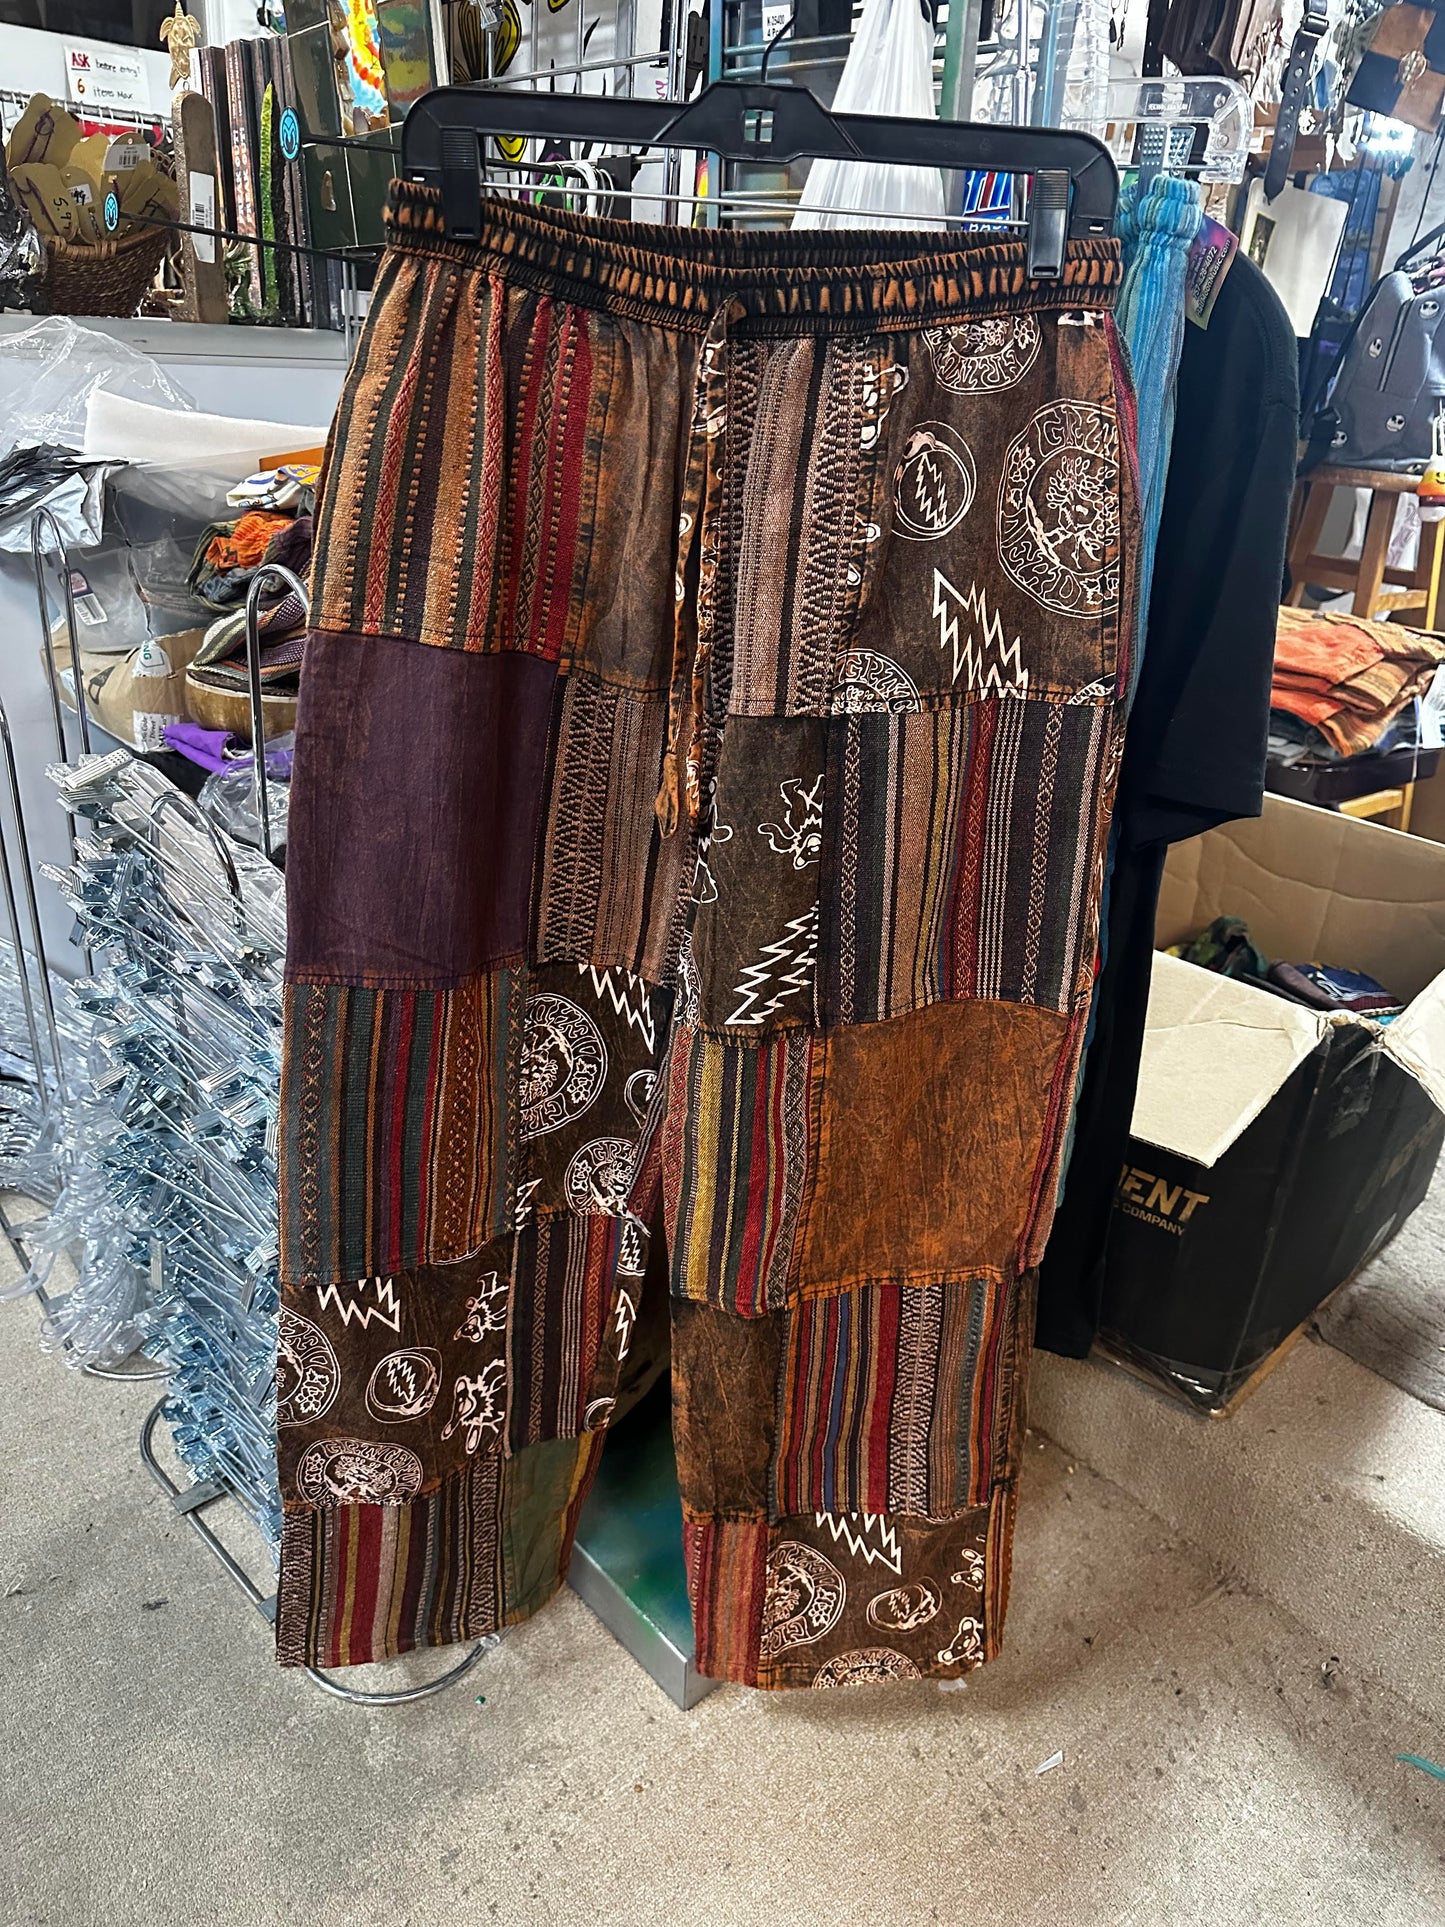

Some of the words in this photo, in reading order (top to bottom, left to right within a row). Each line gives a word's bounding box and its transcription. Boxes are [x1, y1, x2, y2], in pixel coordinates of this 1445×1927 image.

[72, 52, 91, 68] ASK
[95, 58, 117, 73] before
[77, 78, 86, 94] 6
[94, 87, 115, 97] items
[235, 171, 245, 224] FREAK
[243, 168, 253, 223] FREAK
[1121, 1202, 1186, 1236] COMPANY
